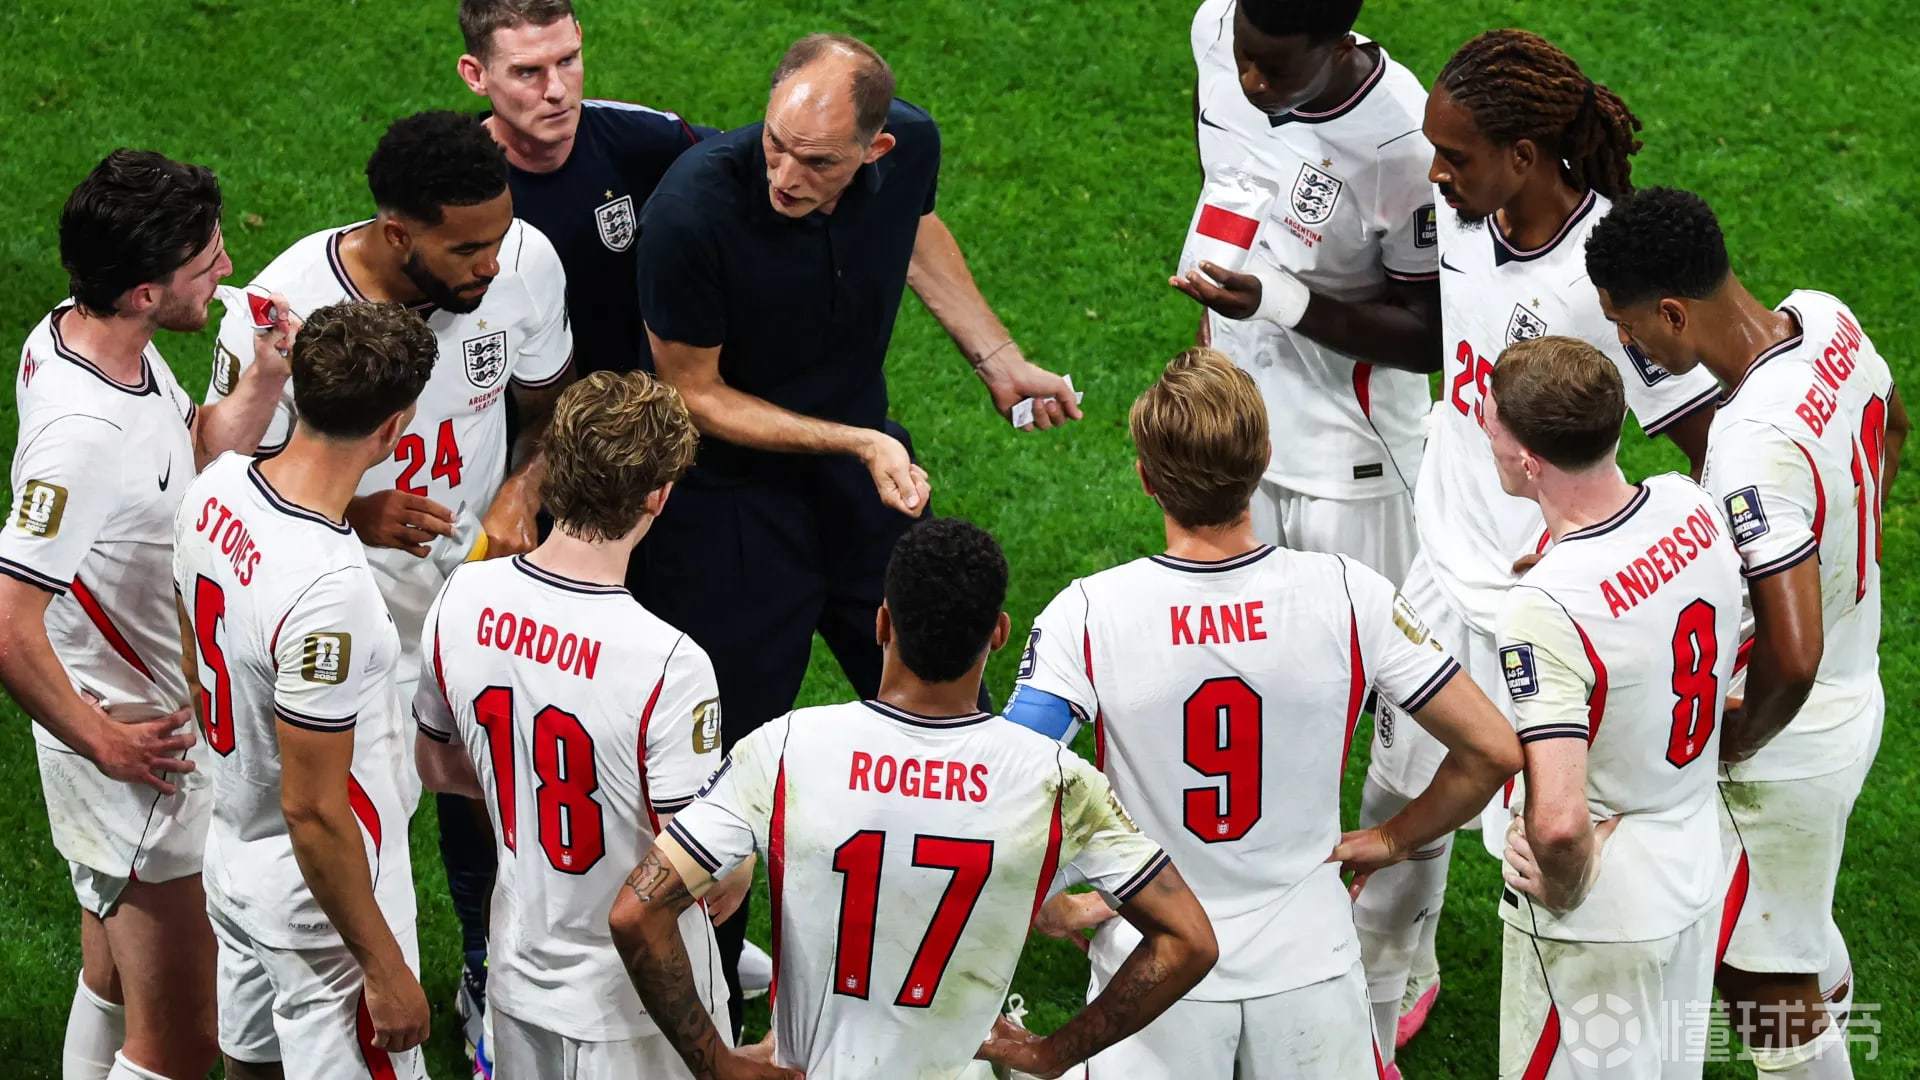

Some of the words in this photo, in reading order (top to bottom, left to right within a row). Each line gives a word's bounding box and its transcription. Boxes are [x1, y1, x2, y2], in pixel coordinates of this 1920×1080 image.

[1284, 216, 1323, 243] ARGENTINA
[1452, 339, 1495, 429] 25
[1795, 311, 1862, 439] BELNGHAM
[394, 418, 464, 497] 24
[196, 496, 261, 587] STONES
[1600, 503, 1720, 619] ANDERSON
[195, 572, 237, 757] 5
[476, 607, 601, 680] GORDON
[1170, 600, 1267, 645] KANE
[1665, 597, 1718, 769] 8
[472, 686, 606, 875] 18
[849, 750, 989, 803] ROGERS
[1183, 676, 1263, 844] 9
[831, 829, 995, 1009] 17
